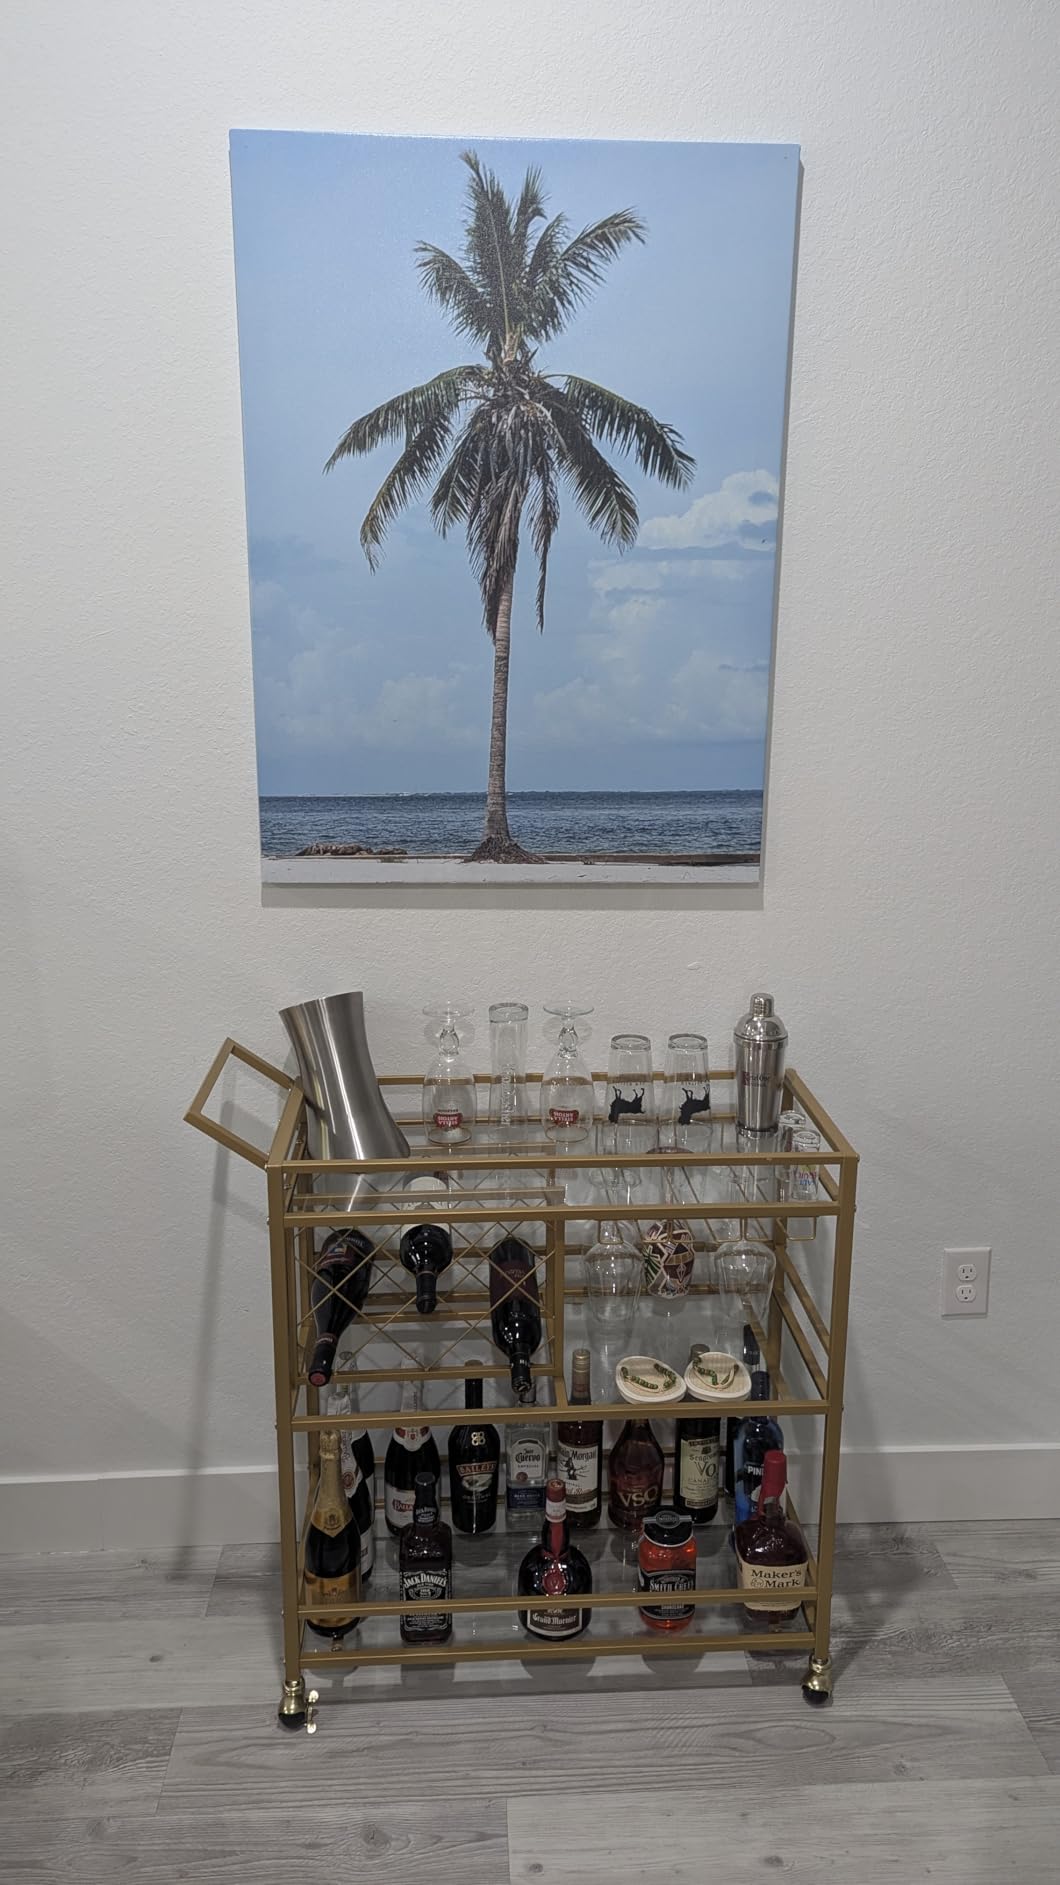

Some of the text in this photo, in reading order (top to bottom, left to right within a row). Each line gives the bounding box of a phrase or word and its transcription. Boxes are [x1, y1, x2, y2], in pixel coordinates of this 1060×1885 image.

[515, 1453, 541, 1463] Cuervo
[751, 1569, 802, 1579] Maker's
[403, 1576, 420, 1588] JACK
[649, 1580, 672, 1592] SMITH
[765, 1579, 800, 1588] Mark
[532, 1612, 577, 1625] Grand Marnier
